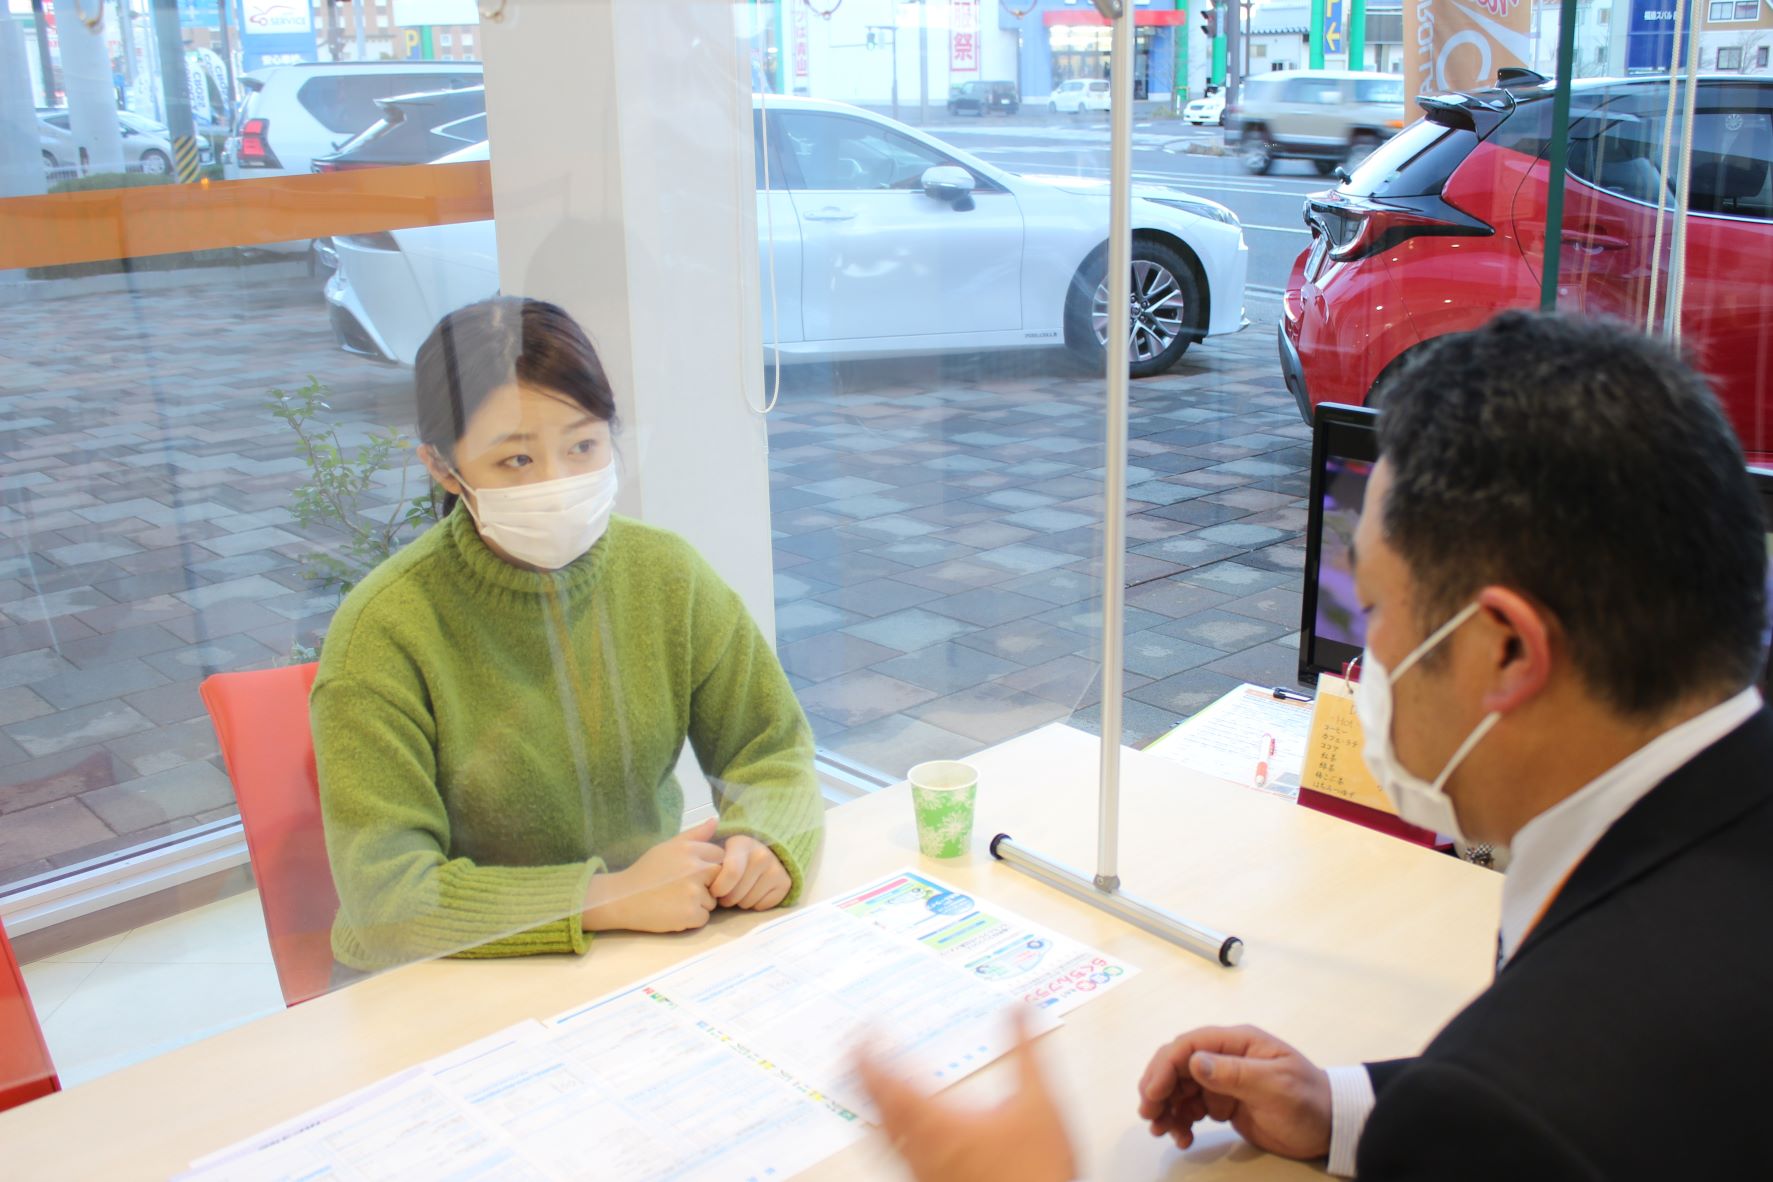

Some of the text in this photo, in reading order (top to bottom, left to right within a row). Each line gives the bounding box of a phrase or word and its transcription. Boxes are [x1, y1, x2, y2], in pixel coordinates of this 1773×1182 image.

[405, 29, 419, 57] P
[1324, 724, 1348, 734] コーヒー
[1320, 742, 1339, 751] ココア
